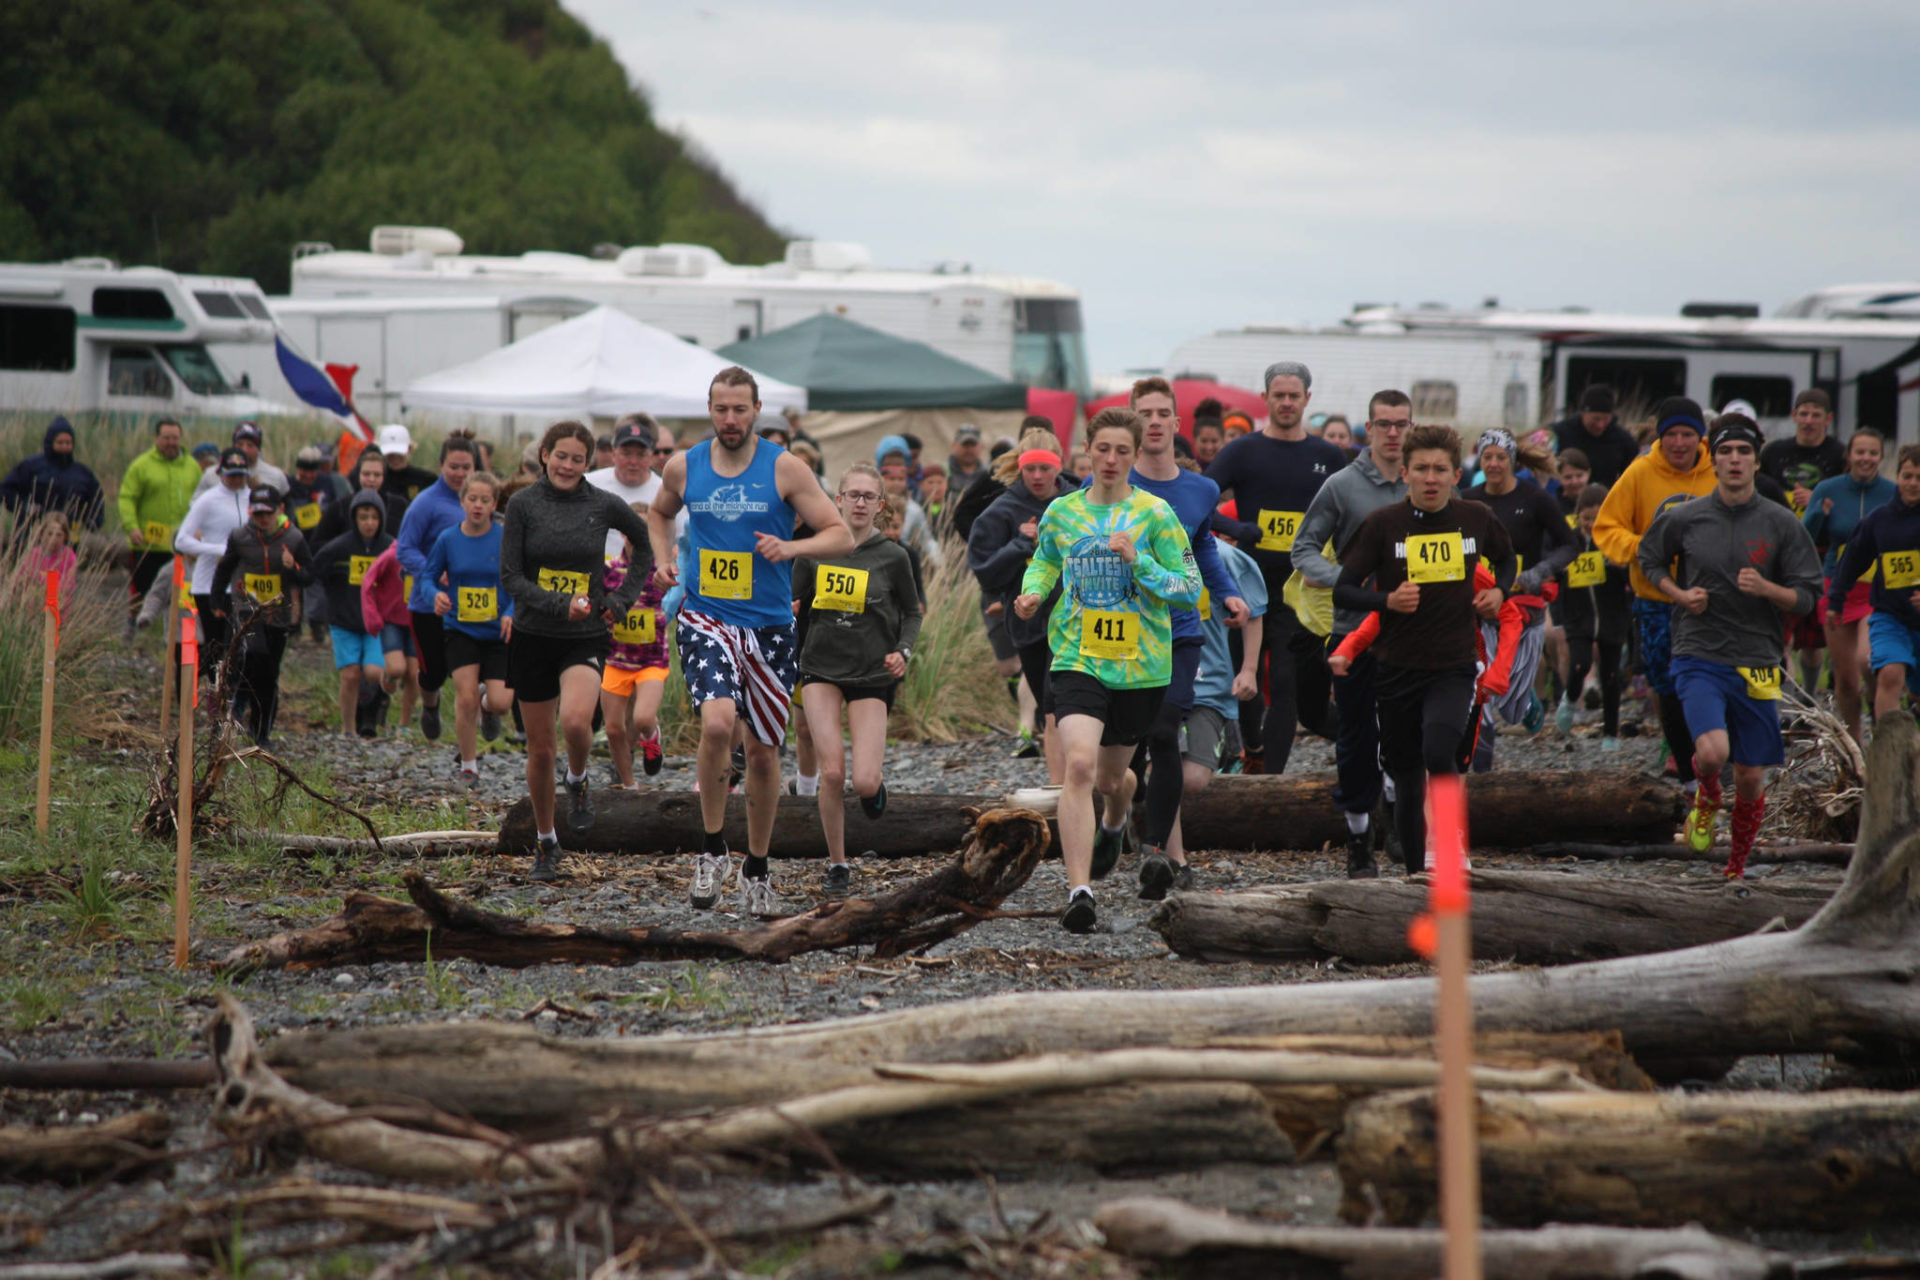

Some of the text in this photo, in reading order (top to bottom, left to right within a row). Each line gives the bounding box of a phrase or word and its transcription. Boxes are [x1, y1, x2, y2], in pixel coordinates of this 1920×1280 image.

[1268, 518, 1294, 536] 456
[1419, 541, 1451, 564] 470
[709, 557, 739, 581] 426
[825, 572, 855, 596] 550
[1081, 576, 1120, 592] INVITE
[466, 593, 490, 609] 520
[1094, 617, 1125, 642] 411
